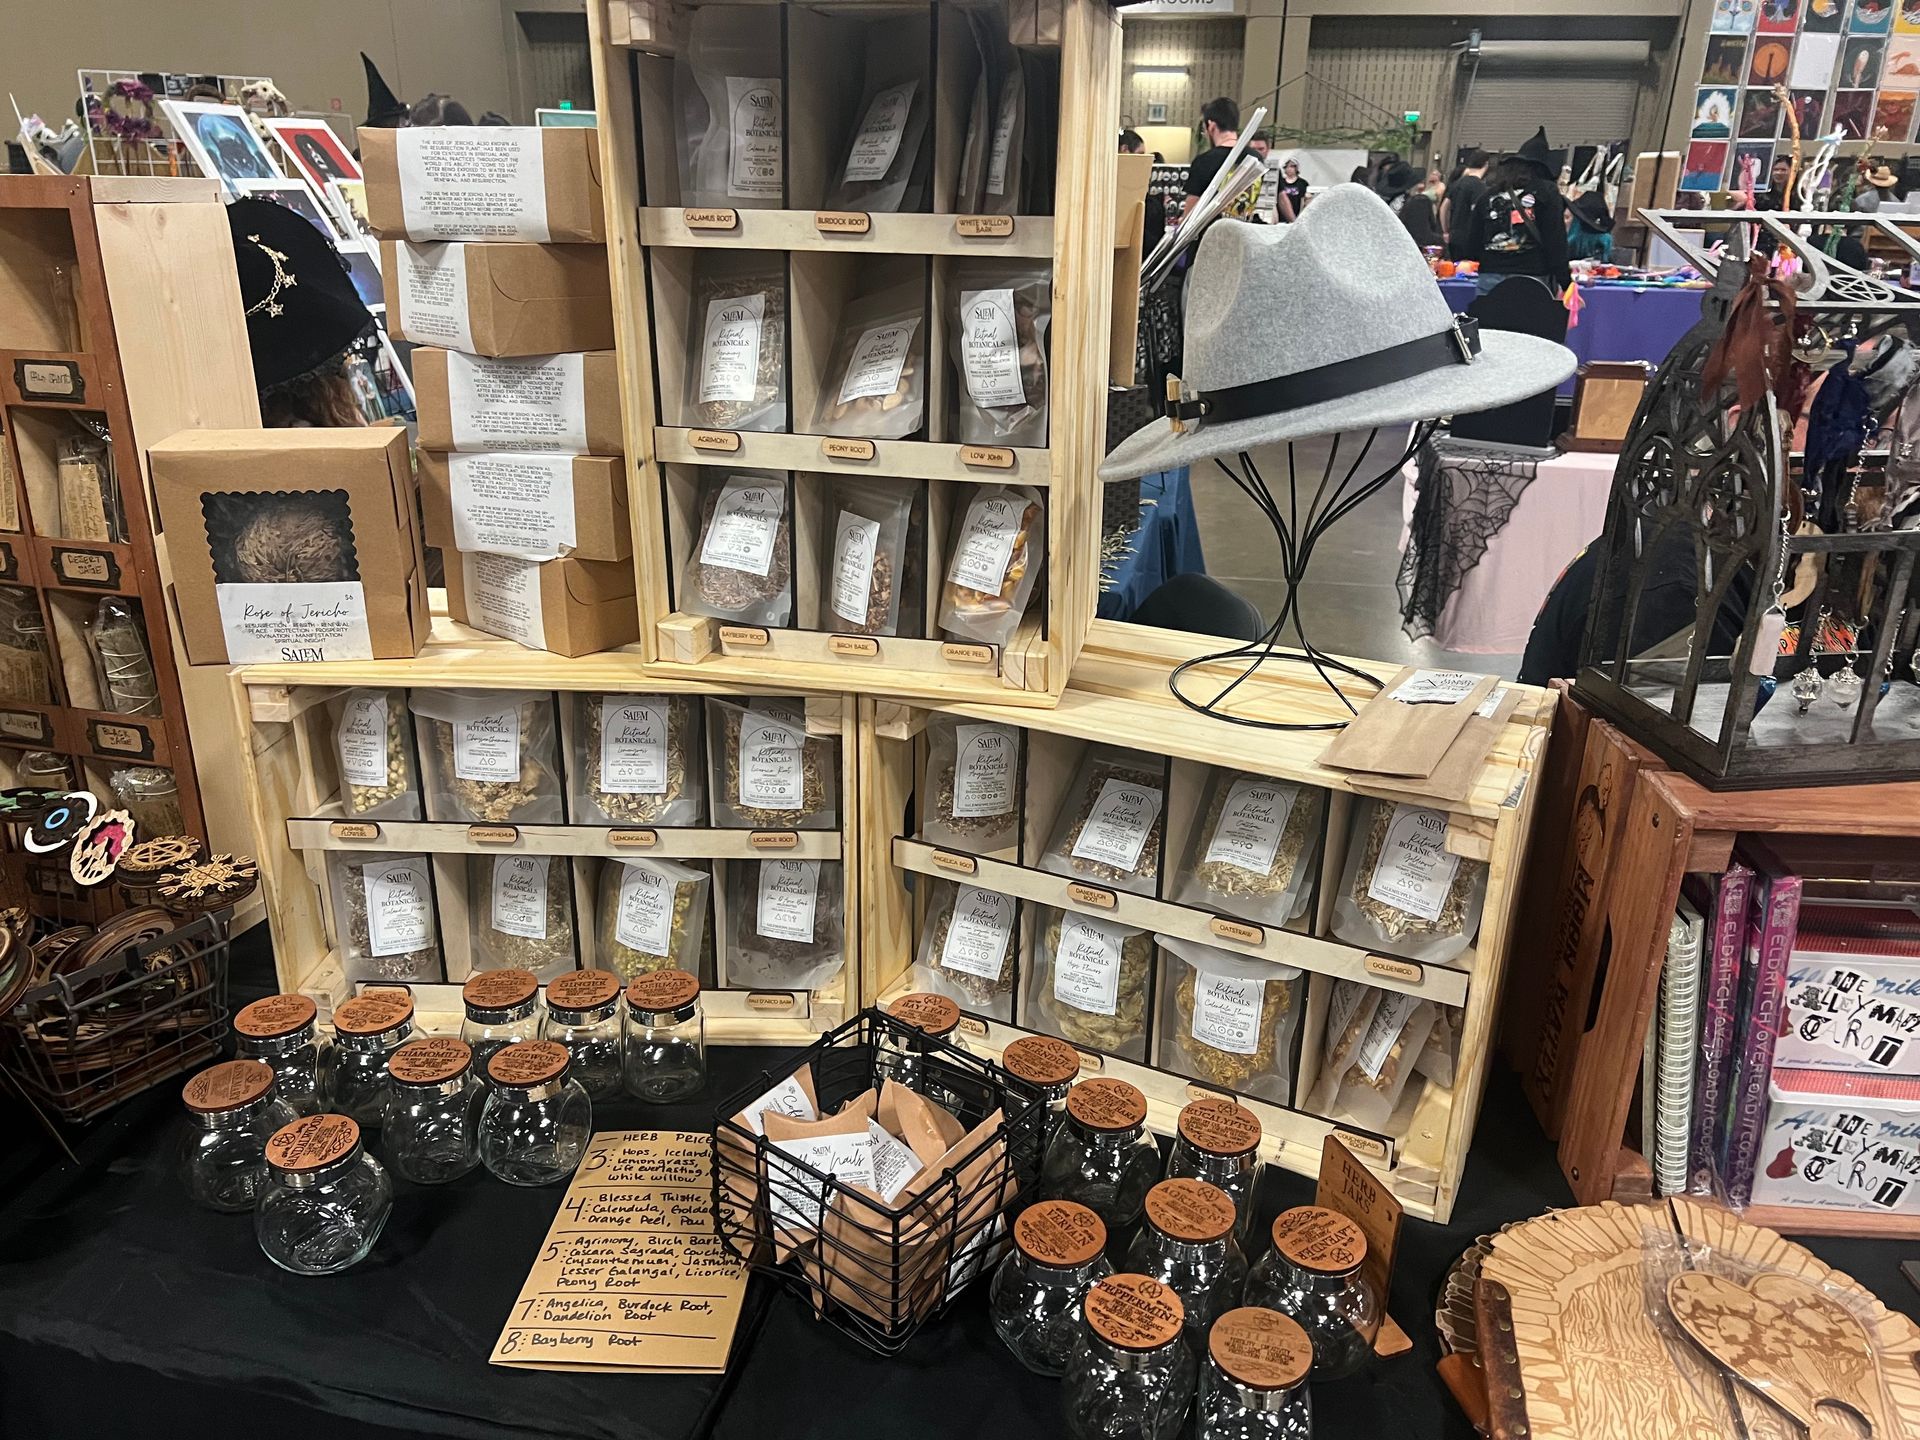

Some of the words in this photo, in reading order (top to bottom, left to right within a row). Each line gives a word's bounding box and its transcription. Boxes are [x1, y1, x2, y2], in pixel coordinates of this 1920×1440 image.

[686, 214, 716, 222] CALAMUS
[717, 215, 733, 223] ROOT
[818, 218, 847, 226] BURDOCK
[848, 218, 866, 226] ROOT
[958, 219, 981, 227] WHITE
[982, 219, 1010, 227] WILLOW
[976, 226, 993, 234] BARK
[712, 339, 750, 348] BOTANICALS
[968, 340, 1006, 349] BOTANICALS
[698, 436, 728, 444] AGRIMONY
[829, 444, 848, 452] PEONY
[850, 446, 866, 454] ROOT
[987, 454, 1003, 462] JOHN
[244, 603, 273, 620] Rose
[280, 603, 293, 624] of
[300, 602, 350, 620] Jericho
[722, 630, 750, 640] BAYBERRY
[836, 642, 852, 650] BIRCH
[281, 647, 324, 662] SALEM
[946, 648, 970, 656] ORANGE
[970, 650, 986, 658] PEEL
[623, 710, 648, 721] SALEM
[466, 724, 510, 733] BOTANICALS
[622, 725, 650, 738] Ritual
[614, 736, 657, 745] BOTANICALS
[760, 730, 787, 745] SALEM
[976, 737, 1001, 750] SALEM
[752, 755, 792, 764] BOTANICALS
[968, 762, 1008, 772] BOTANICALS
[1118, 792, 1144, 806] SALEM
[1248, 790, 1276, 802] SALEM
[1241, 804, 1271, 816] Ritual
[1102, 812, 1142, 826] BOTANICALS
[1232, 810, 1274, 825] BOTANICALS
[1416, 815, 1447, 834] SALEM
[1408, 832, 1444, 853] Ritual
[780, 860, 802, 872] SALEM
[934, 855, 958, 865] ANGELICA
[959, 860, 972, 868] ROOT
[386, 872, 412, 884] SALEM
[770, 885, 808, 895] BOTANICALS
[1076, 888, 1106, 900] DANDELION
[381, 896, 424, 908] BOTANICALS
[1220, 924, 1253, 938] OATSTRAW
[1076, 941, 1104, 959] Ritual
[1068, 952, 1110, 967] BOTANICALS
[1372, 962, 1412, 976] GOLDENROD
[1716, 921, 1736, 1012] ELDRITCH
[560, 980, 607, 988] GINGER
[632, 979, 694, 990] ROSEMARY
[1760, 934, 1786, 1026] ELDRITCH
[1828, 970, 1869, 994] THE
[1206, 989, 1251, 1007] BOTANICALS
[902, 1002, 923, 1010] BAY
[924, 1005, 952, 1016] LEAF
[1800, 1014, 1904, 1066] TAROT
[500, 1048, 566, 1063] MUGWORT
[1016, 1040, 1076, 1072] CALENDULA
[1079, 1056, 1098, 1067] OWERS
[1702, 1015, 1726, 1102] OVERLOAD
[1746, 1029, 1768, 1115] OVERLOAD
[1186, 1107, 1259, 1134] EUCALYPTUS
[1834, 1114, 1873, 1136] THE
[284, 1115, 325, 1168] SANDALWOOD
[623, 1133, 658, 1142] HERB
[1337, 1132, 1379, 1150] COUCHGRASS
[812, 1145, 832, 1156] SALEM
[1352, 1139, 1366, 1150] ROOT
[586, 1148, 608, 1170] 3
[623, 1148, 658, 1158] Hops,
[666, 1148, 712, 1158] Icelandi
[613, 1164, 634, 1172] Life
[638, 1164, 711, 1177] everlasting,
[651, 1174, 697, 1183] willow
[1342, 1160, 1376, 1204] HERB
[1804, 1156, 1908, 1208] TAROT
[600, 1193, 652, 1202] Blessed
[661, 1193, 708, 1205] Thistle,
[1342, 1178, 1370, 1214] JARS
[565, 1197, 588, 1222] 4
[594, 1204, 666, 1215] Calendula,
[1160, 1186, 1230, 1225] AGRIMONY
[588, 1215, 632, 1226] Orange
[641, 1215, 672, 1228] Peel,
[680, 1216, 705, 1226] Pau
[1047, 1208, 1090, 1247] VERVAIN
[574, 1236, 639, 1248] Agrimony,
[648, 1236, 682, 1246] Birch
[690, 1236, 721, 1246] Bark
[1294, 1224, 1358, 1261] LAVENDER
[544, 1240, 568, 1262] 5
[570, 1248, 614, 1257] Cascara
[620, 1247, 678, 1259] Sagrada,
[562, 1267, 605, 1276] Lesser
[609, 1266, 680, 1279] Galangal,
[686, 1268, 741, 1280] Licorice,
[557, 1278, 598, 1291] Peony
[606, 1278, 641, 1288] Root
[519, 1298, 545, 1321] 7
[546, 1298, 609, 1312] Angelica,
[618, 1299, 674, 1311] Burdock
[680, 1300, 715, 1315] Root,
[1098, 1280, 1184, 1327] PEPPERMINT
[544, 1310, 613, 1322] Dandelion
[624, 1312, 658, 1320] Root
[501, 1331, 525, 1355] 8
[532, 1333, 595, 1348] Bayberry
[608, 1334, 642, 1346] Root
